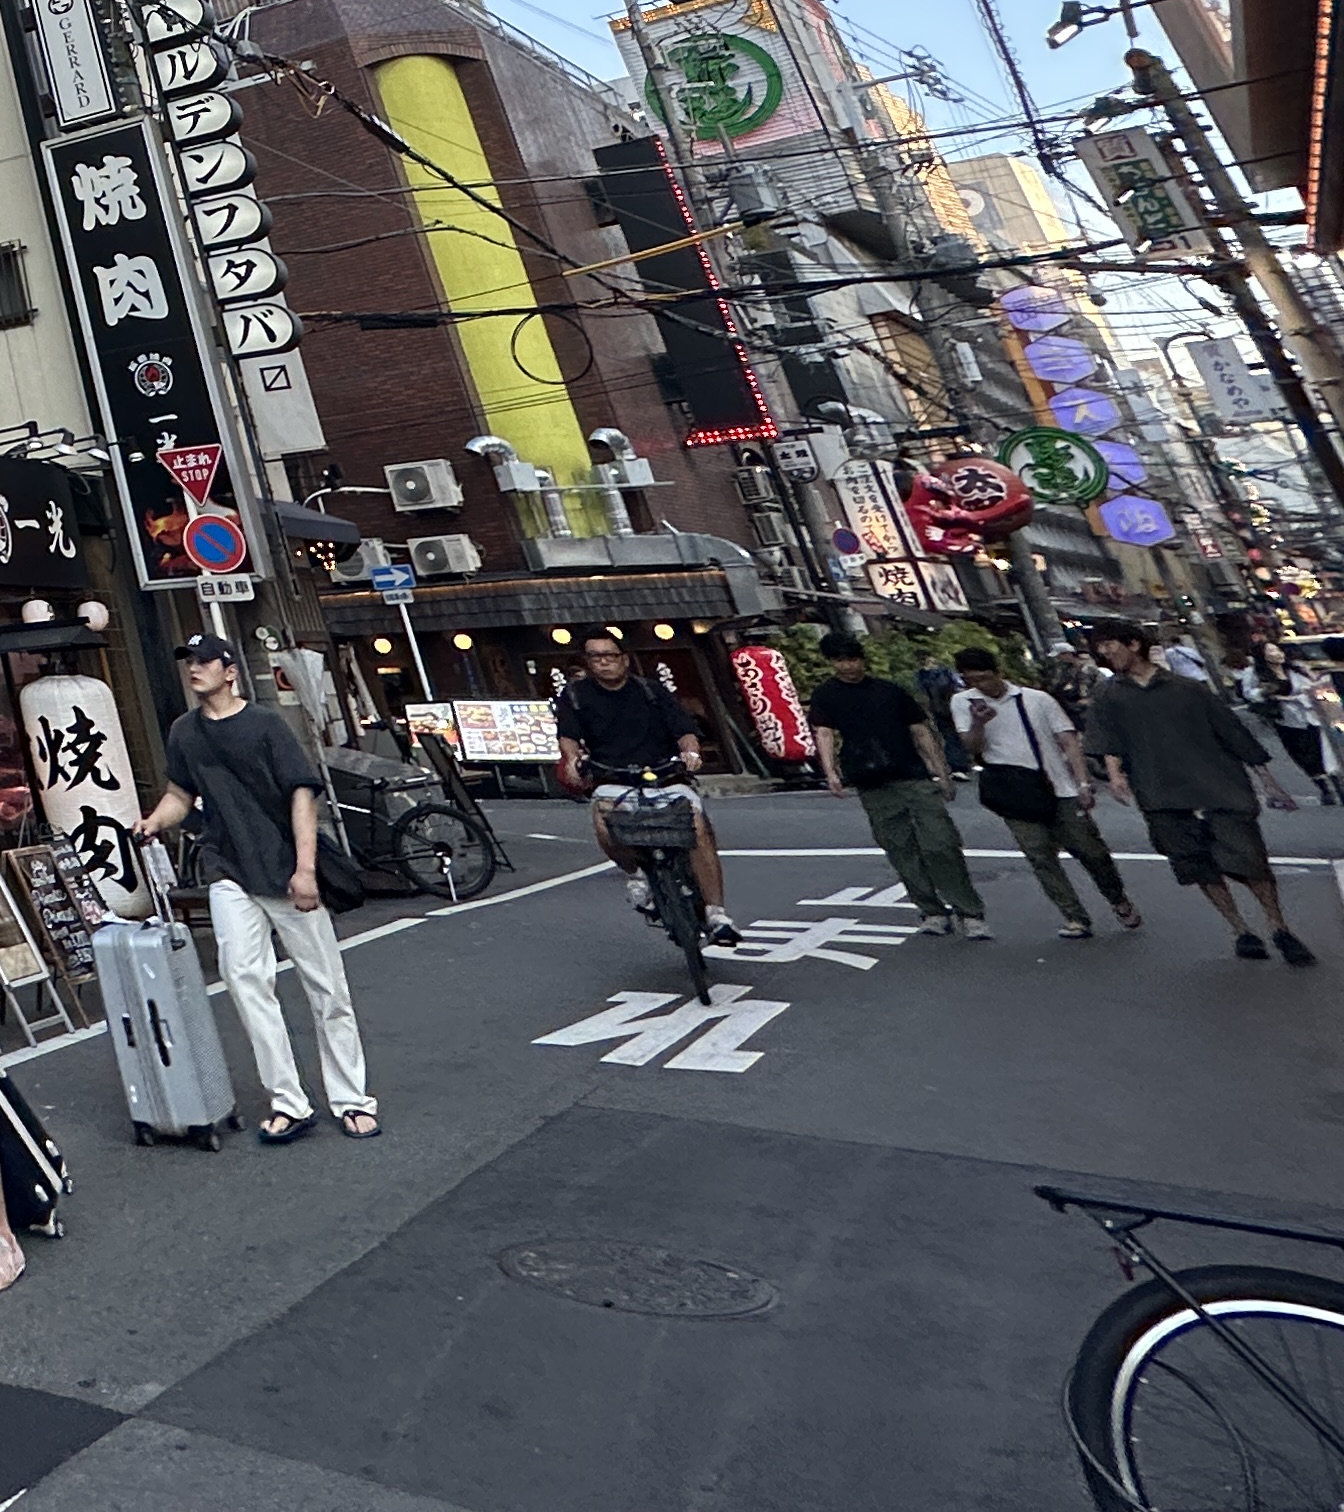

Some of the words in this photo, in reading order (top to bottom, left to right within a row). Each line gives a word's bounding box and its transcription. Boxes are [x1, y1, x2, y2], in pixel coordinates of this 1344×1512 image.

[59, 17, 92, 108] GERRARD
[71, 155, 169, 326] 焼肉
[173, 452, 212, 470] 止まれ
[181, 468, 209, 482] STOP
[201, 580, 250, 597] 自動車
[38, 705, 139, 893] 焼肉
